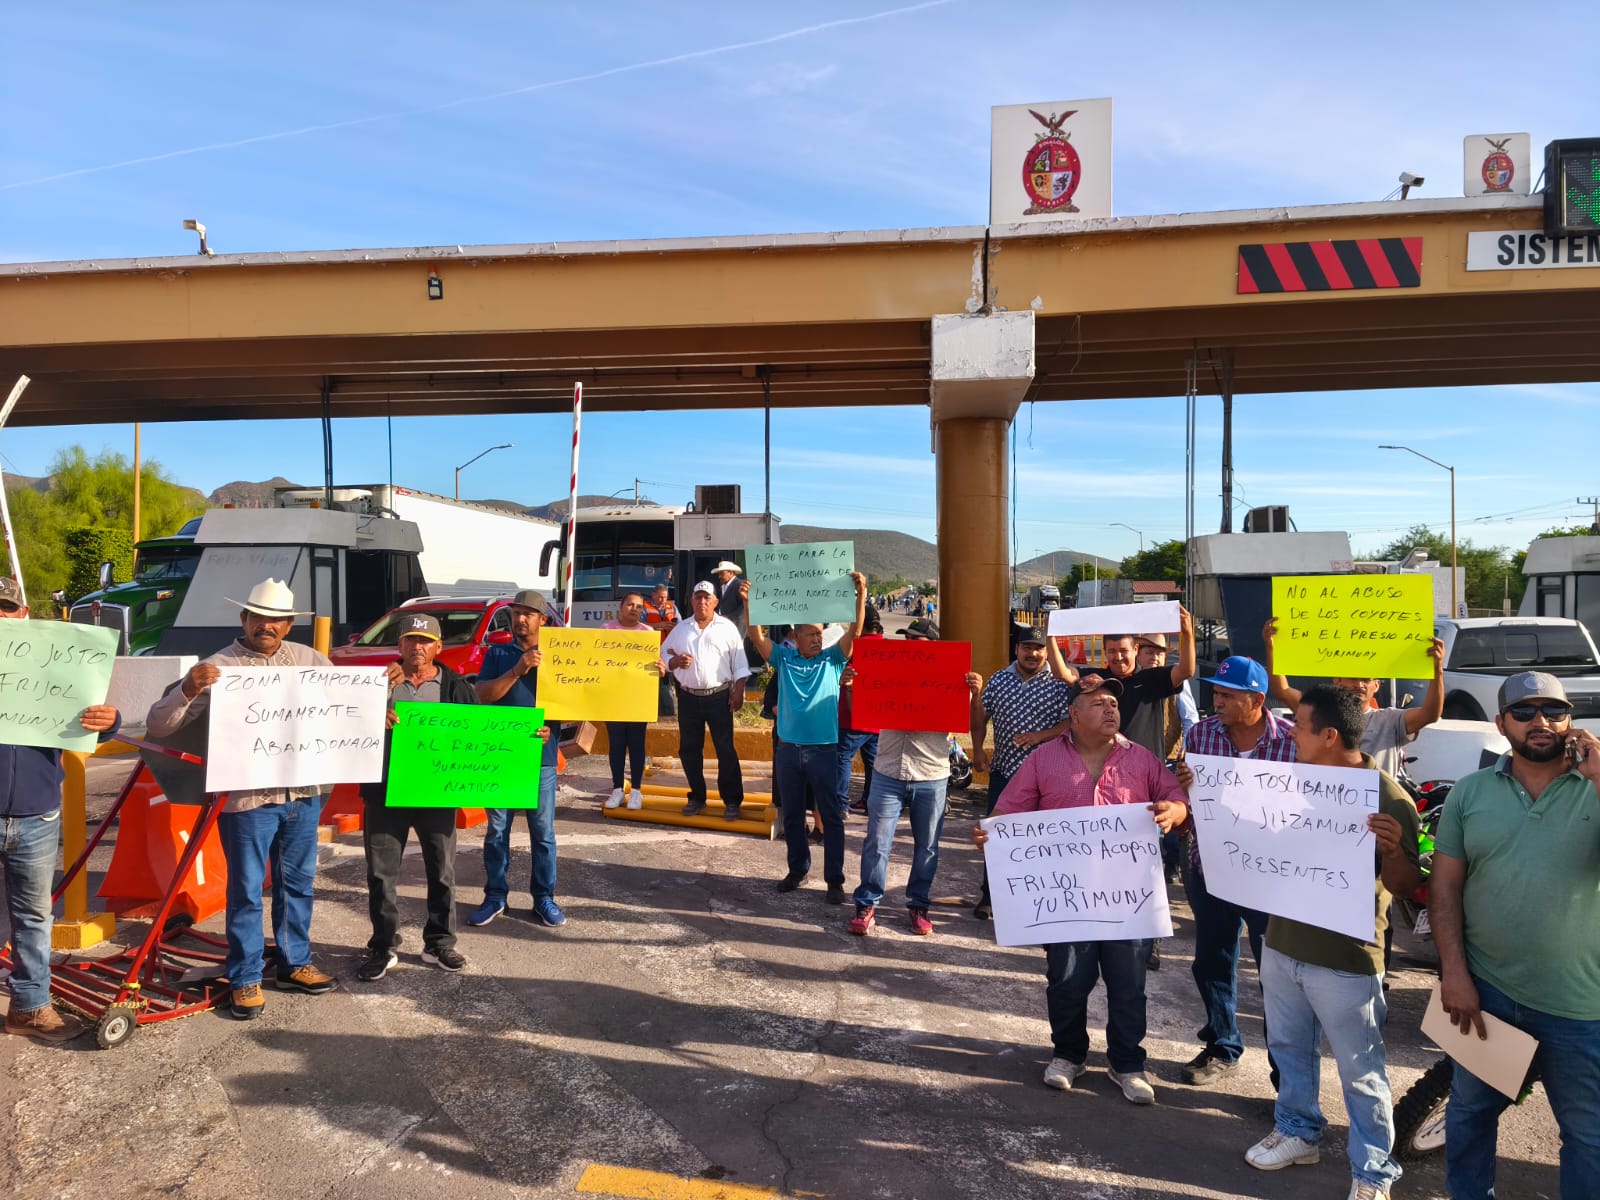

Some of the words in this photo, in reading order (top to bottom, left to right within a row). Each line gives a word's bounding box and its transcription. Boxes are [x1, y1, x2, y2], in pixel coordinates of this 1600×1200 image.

[755, 552, 789, 564] APOYO
[798, 548, 826, 561] PARA
[832, 547, 847, 559] LA
[754, 571, 781, 583] ZONA
[788, 568, 830, 579] INDIGENA
[838, 568, 852, 577] DE
[755, 586, 768, 600] LA
[773, 588, 797, 598] ZONA
[806, 588, 830, 598] NORTE
[835, 589, 849, 598] DE
[1286, 585, 1308, 599] NO
[1320, 587, 1338, 599] AL
[1350, 586, 1403, 599] ABUSO
[770, 601, 809, 614] SINALOA
[1290, 607, 1310, 620] DE
[1318, 607, 1340, 620] LOS
[1350, 608, 1423, 622] COYOTES
[549, 637, 582, 649] BANCA
[1291, 627, 1310, 640] EN
[1319, 629, 1341, 640] EL
[1350, 629, 1398, 641] PRESIO
[1404, 632, 1425, 642] AL
[40, 643, 108, 669] JUSTO
[552, 655, 577, 666] PARA
[587, 657, 599, 667] LA
[606, 659, 628, 668] ZONA
[1315, 647, 1377, 664] YURIMUNY
[1218, 662, 1230, 675] C
[0, 672, 78, 701] FRIJOL
[225, 673, 281, 691] ZONA
[299, 669, 386, 687] TEMPORAL
[245, 701, 361, 724] SUMAMENTE
[405, 708, 470, 730] PRECIOS
[481, 718, 532, 733] JUSTOS
[253, 736, 380, 758] ABANDONADA
[416, 738, 440, 752] AL
[452, 739, 513, 757] FRIJOL
[432, 759, 500, 775] YURIMUNY
[443, 780, 499, 793] NATIVO
[1254, 772, 1358, 807] TOSLIBAMPO
[1363, 789, 1379, 808] I
[1199, 798, 1217, 821] II
[994, 816, 1128, 840] REAPERTURA
[1009, 842, 1093, 863] CENTRO
[1223, 841, 1350, 890] PRESENTES
[1007, 871, 1085, 896] FRIJOL
[1033, 887, 1155, 922] YURIMUNY
